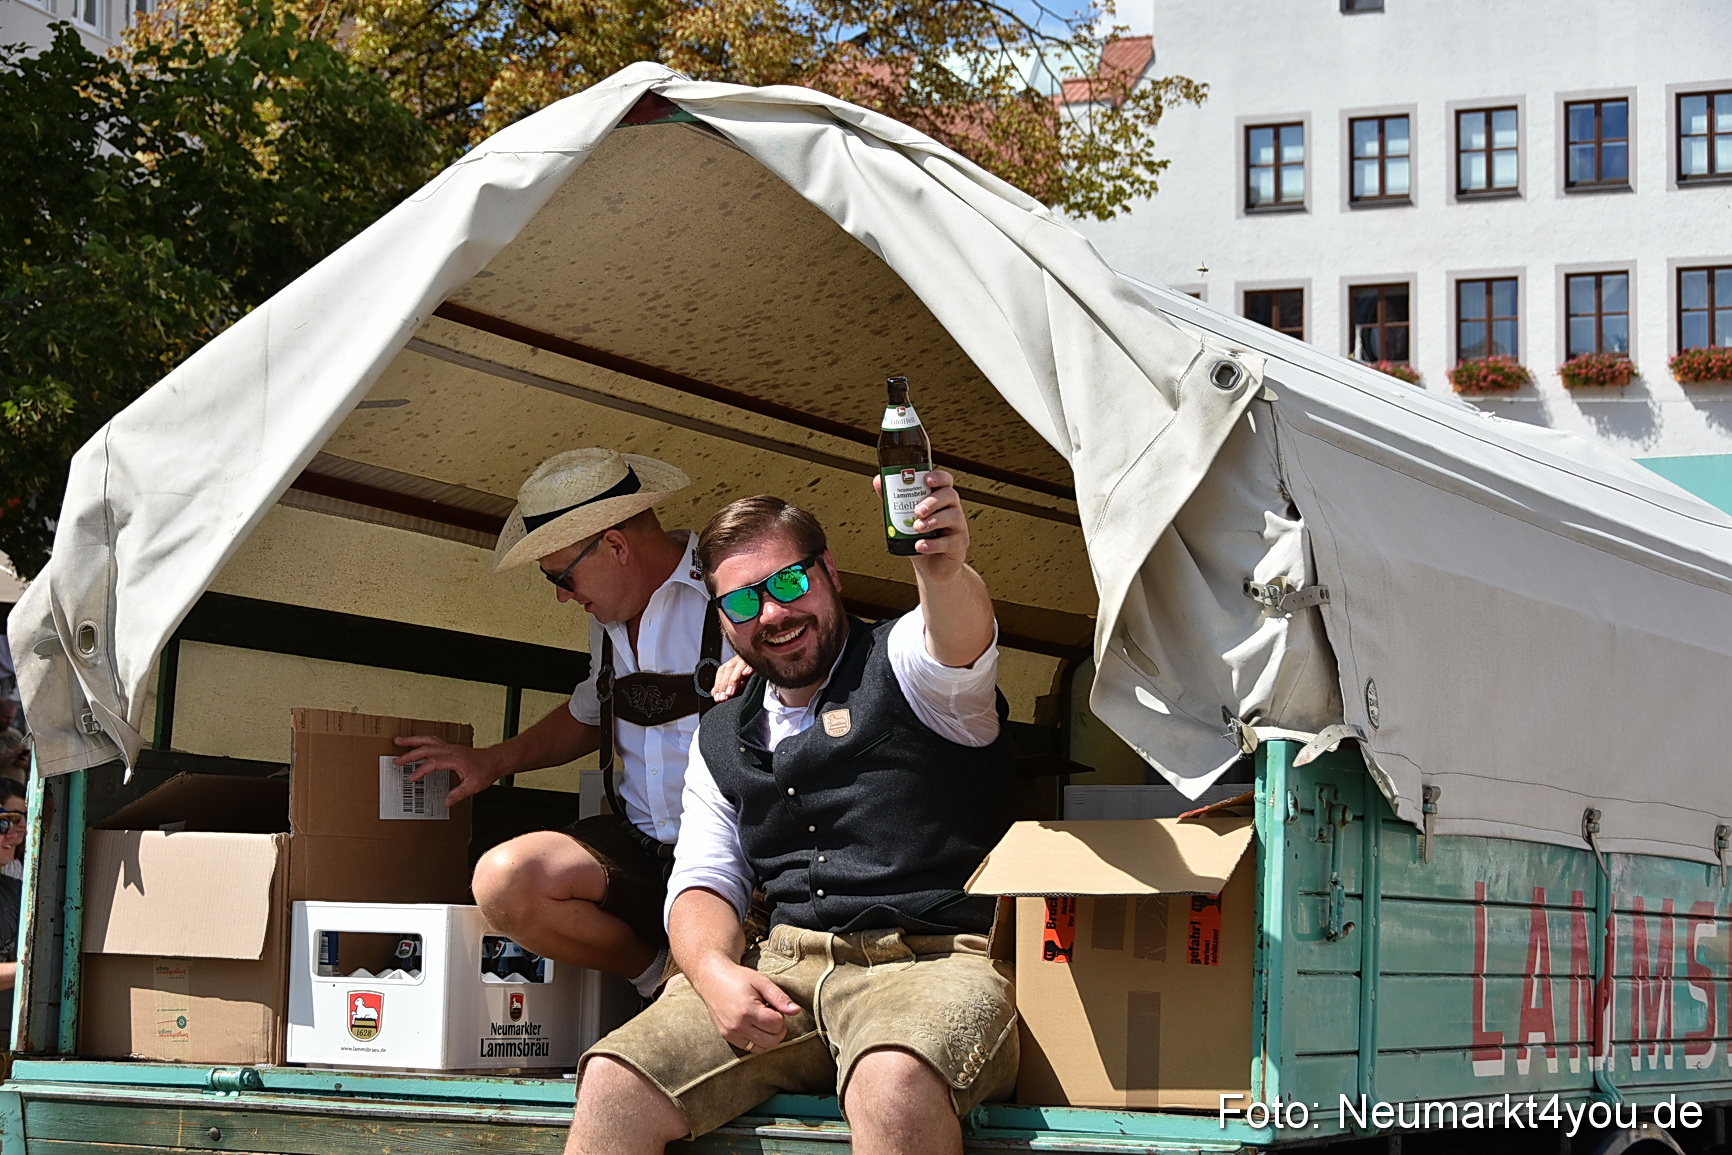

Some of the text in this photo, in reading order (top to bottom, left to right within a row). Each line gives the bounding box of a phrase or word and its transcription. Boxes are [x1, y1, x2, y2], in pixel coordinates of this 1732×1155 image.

[893, 490, 927, 498] Lammsbräu
[1189, 921, 1201, 965] gefahr!
[1471, 881, 1732, 1077] LAMMS
[356, 1029, 372, 1037] 1628
[490, 1021, 542, 1036] Neumarkter
[340, 1045, 387, 1053] www.lammsbraeu.de
[480, 1037, 549, 1058] Lammsbräu
